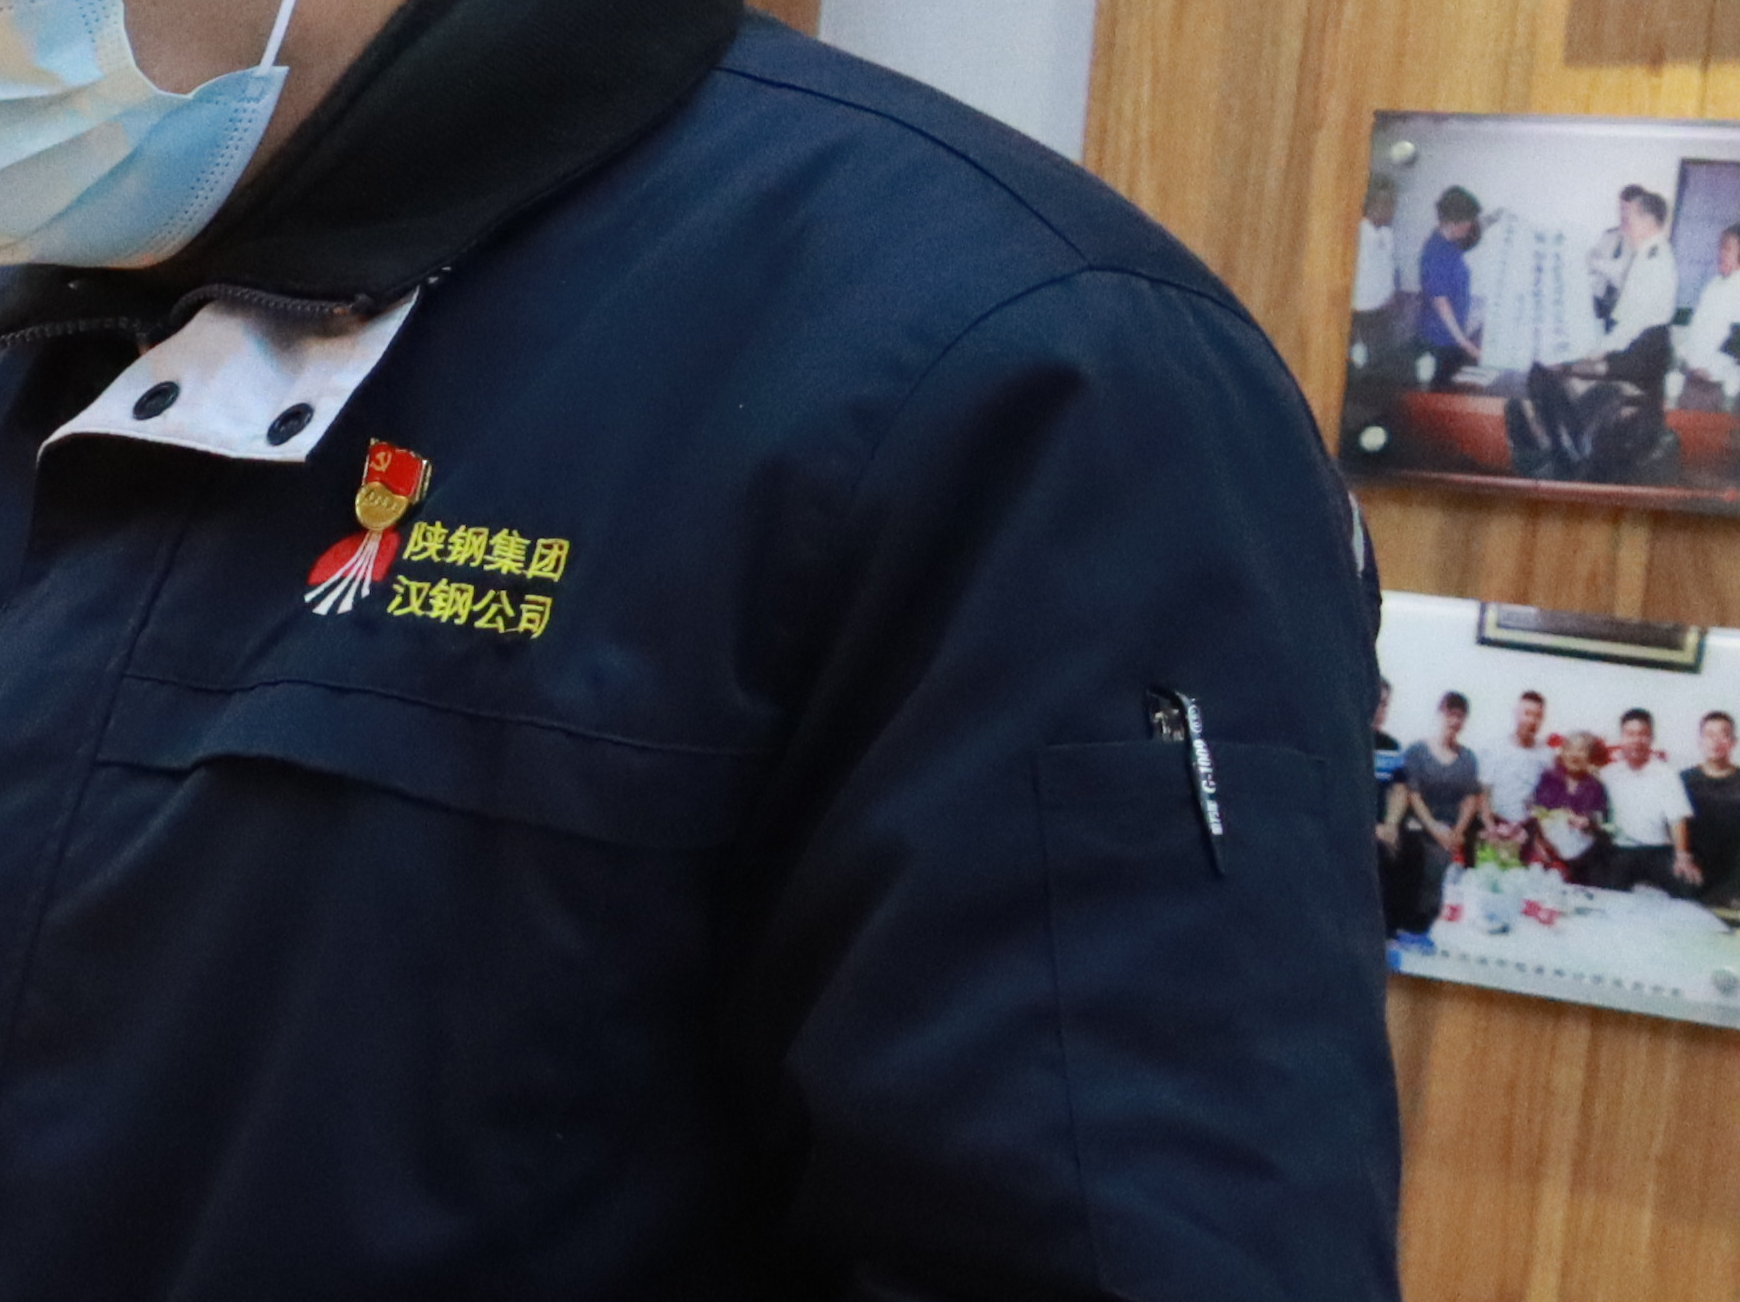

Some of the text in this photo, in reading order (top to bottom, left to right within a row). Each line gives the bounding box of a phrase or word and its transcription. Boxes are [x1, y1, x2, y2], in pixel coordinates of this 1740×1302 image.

[402, 519, 572, 586] 陕钢集团
[386, 573, 555, 641] 汉钢公司
